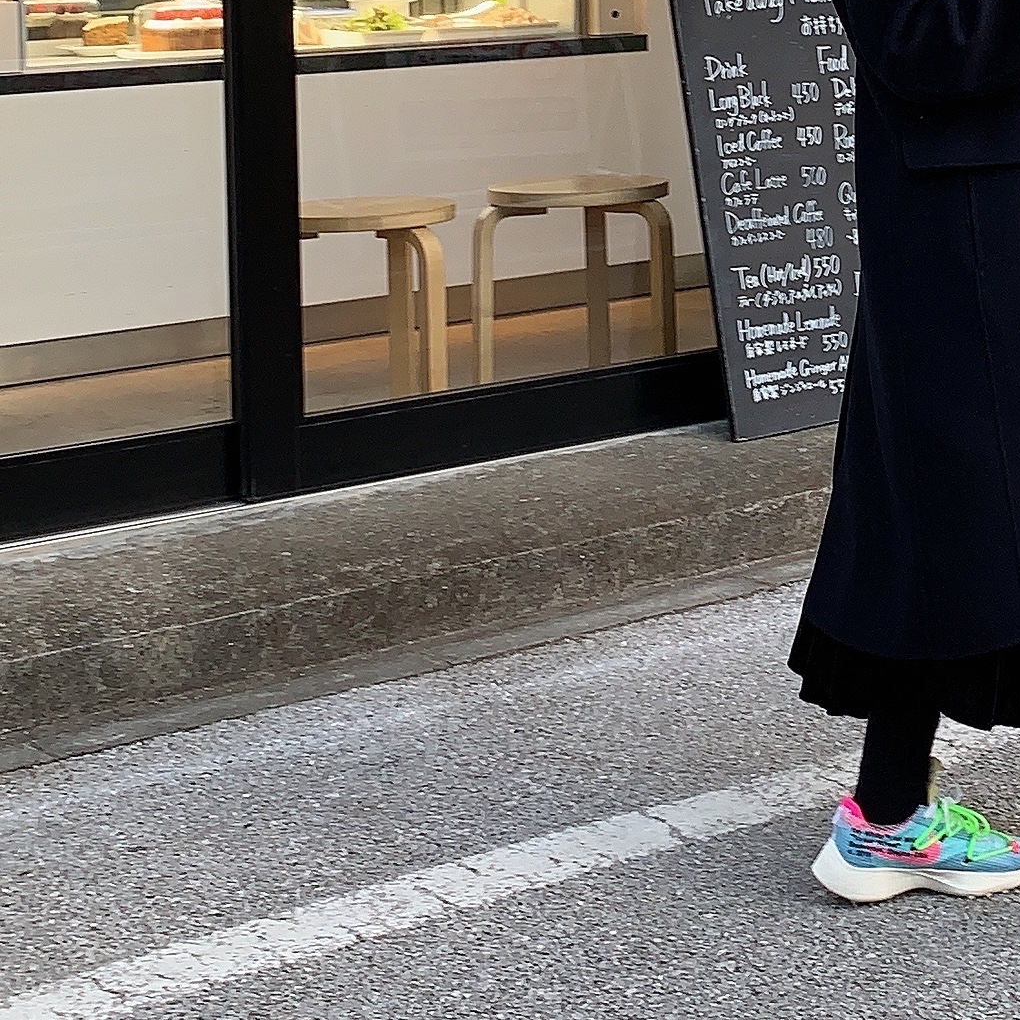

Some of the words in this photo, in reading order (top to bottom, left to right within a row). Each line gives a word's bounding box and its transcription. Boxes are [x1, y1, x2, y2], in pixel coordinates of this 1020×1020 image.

[703, 52, 749, 81] Drink
[815, 44, 849, 75] Food
[708, 88, 739, 117] Long
[791, 82, 820, 104] 450
[797, 126, 823, 147] 450
[805, 226, 834, 250] 480
[812, 254, 841, 278] 550
[821, 331, 849, 352] 550
[828, 378, 846, 395] 55
